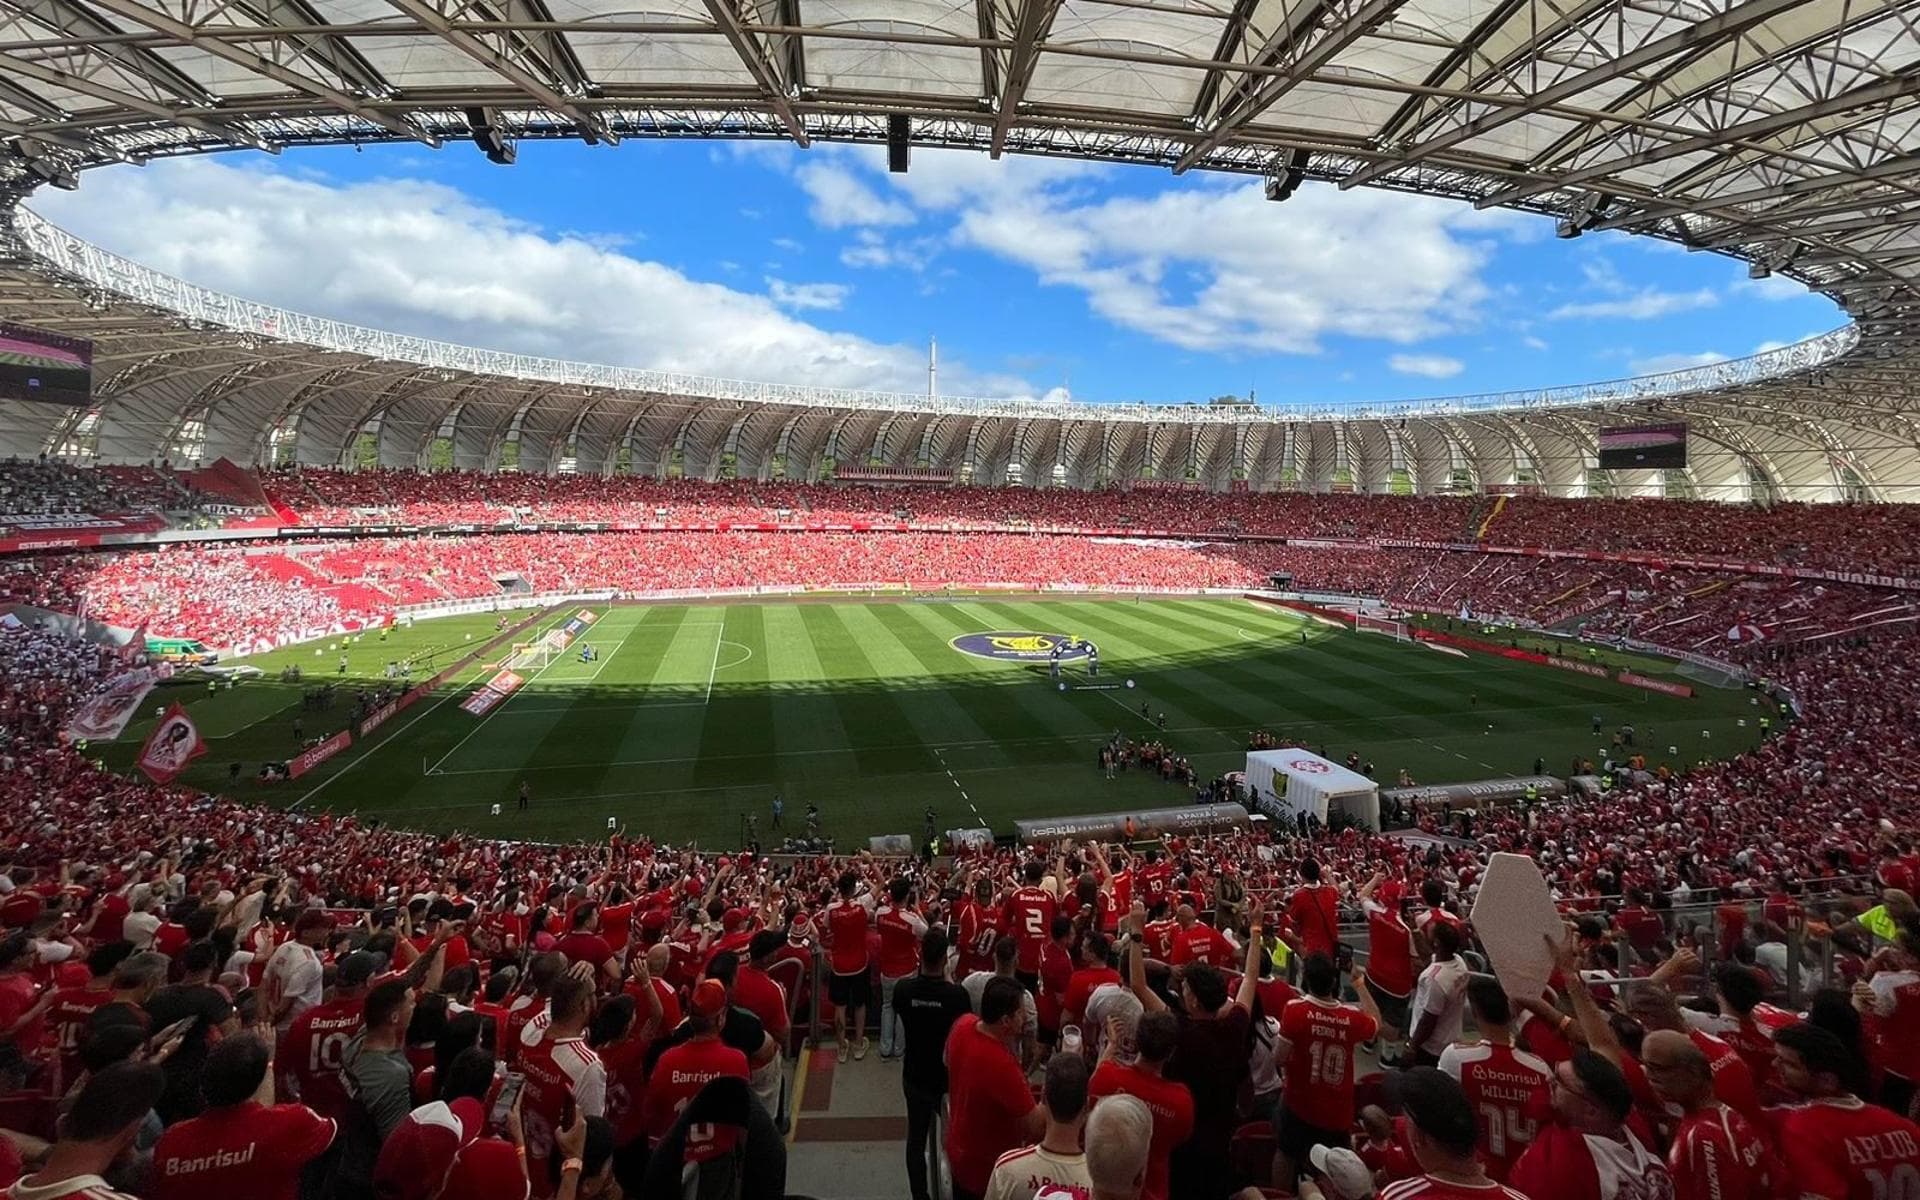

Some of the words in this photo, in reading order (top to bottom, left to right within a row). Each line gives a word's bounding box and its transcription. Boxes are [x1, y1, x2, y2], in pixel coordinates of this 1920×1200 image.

[1025, 908, 1043, 933] 2
[310, 1013, 360, 1029] Banrisul
[1315, 1012, 1351, 1026] Banrisul
[309, 1032, 349, 1071] 10
[1309, 1041, 1346, 1087] 10
[1488, 1068, 1542, 1086] banrisul
[1480, 1102, 1537, 1157] 14
[165, 1141, 256, 1176] Banrisul
